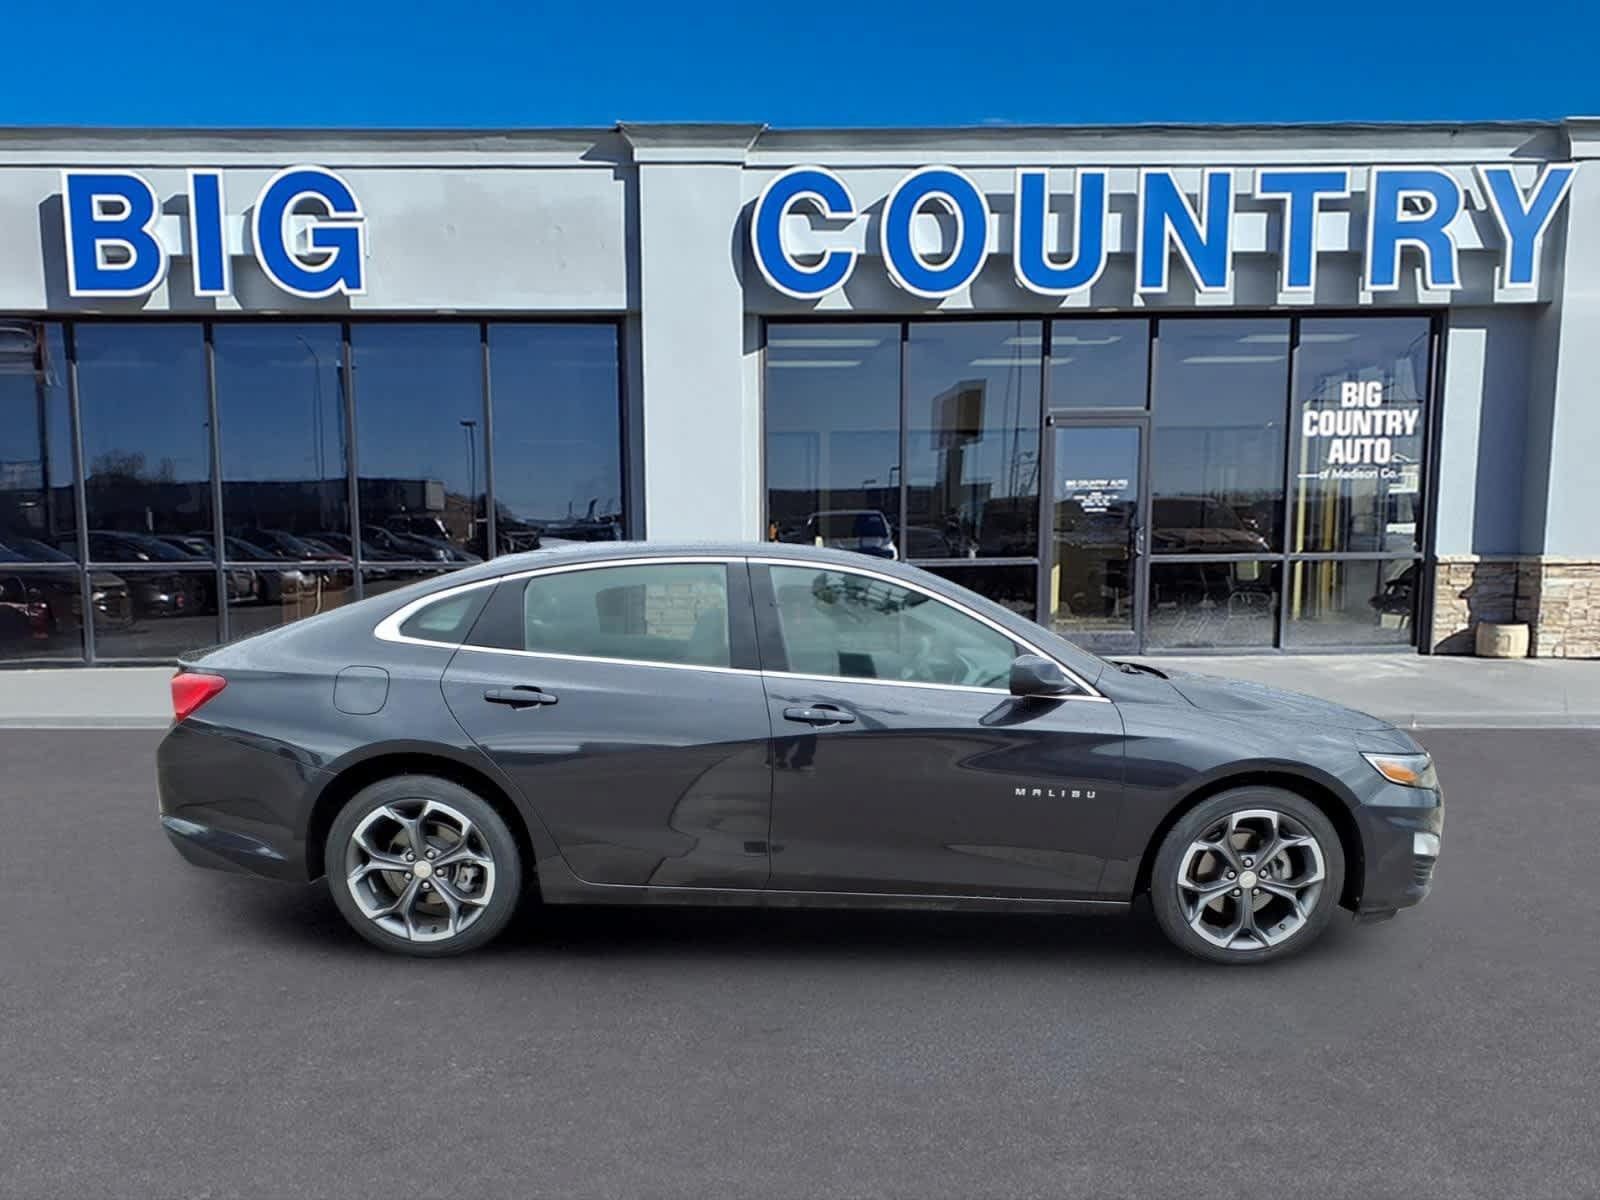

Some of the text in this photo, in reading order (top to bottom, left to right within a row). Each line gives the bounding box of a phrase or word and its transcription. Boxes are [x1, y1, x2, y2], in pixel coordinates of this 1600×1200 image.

[60, 164, 1576, 300] BIG COUNTRY
[1341, 381, 1382, 408] BIG
[1303, 409, 1419, 437] COUNTRY
[1327, 438, 1391, 464] AUTO
[1331, 468, 1378, 480] Madison
[1015, 788, 1096, 799] MALIBU
